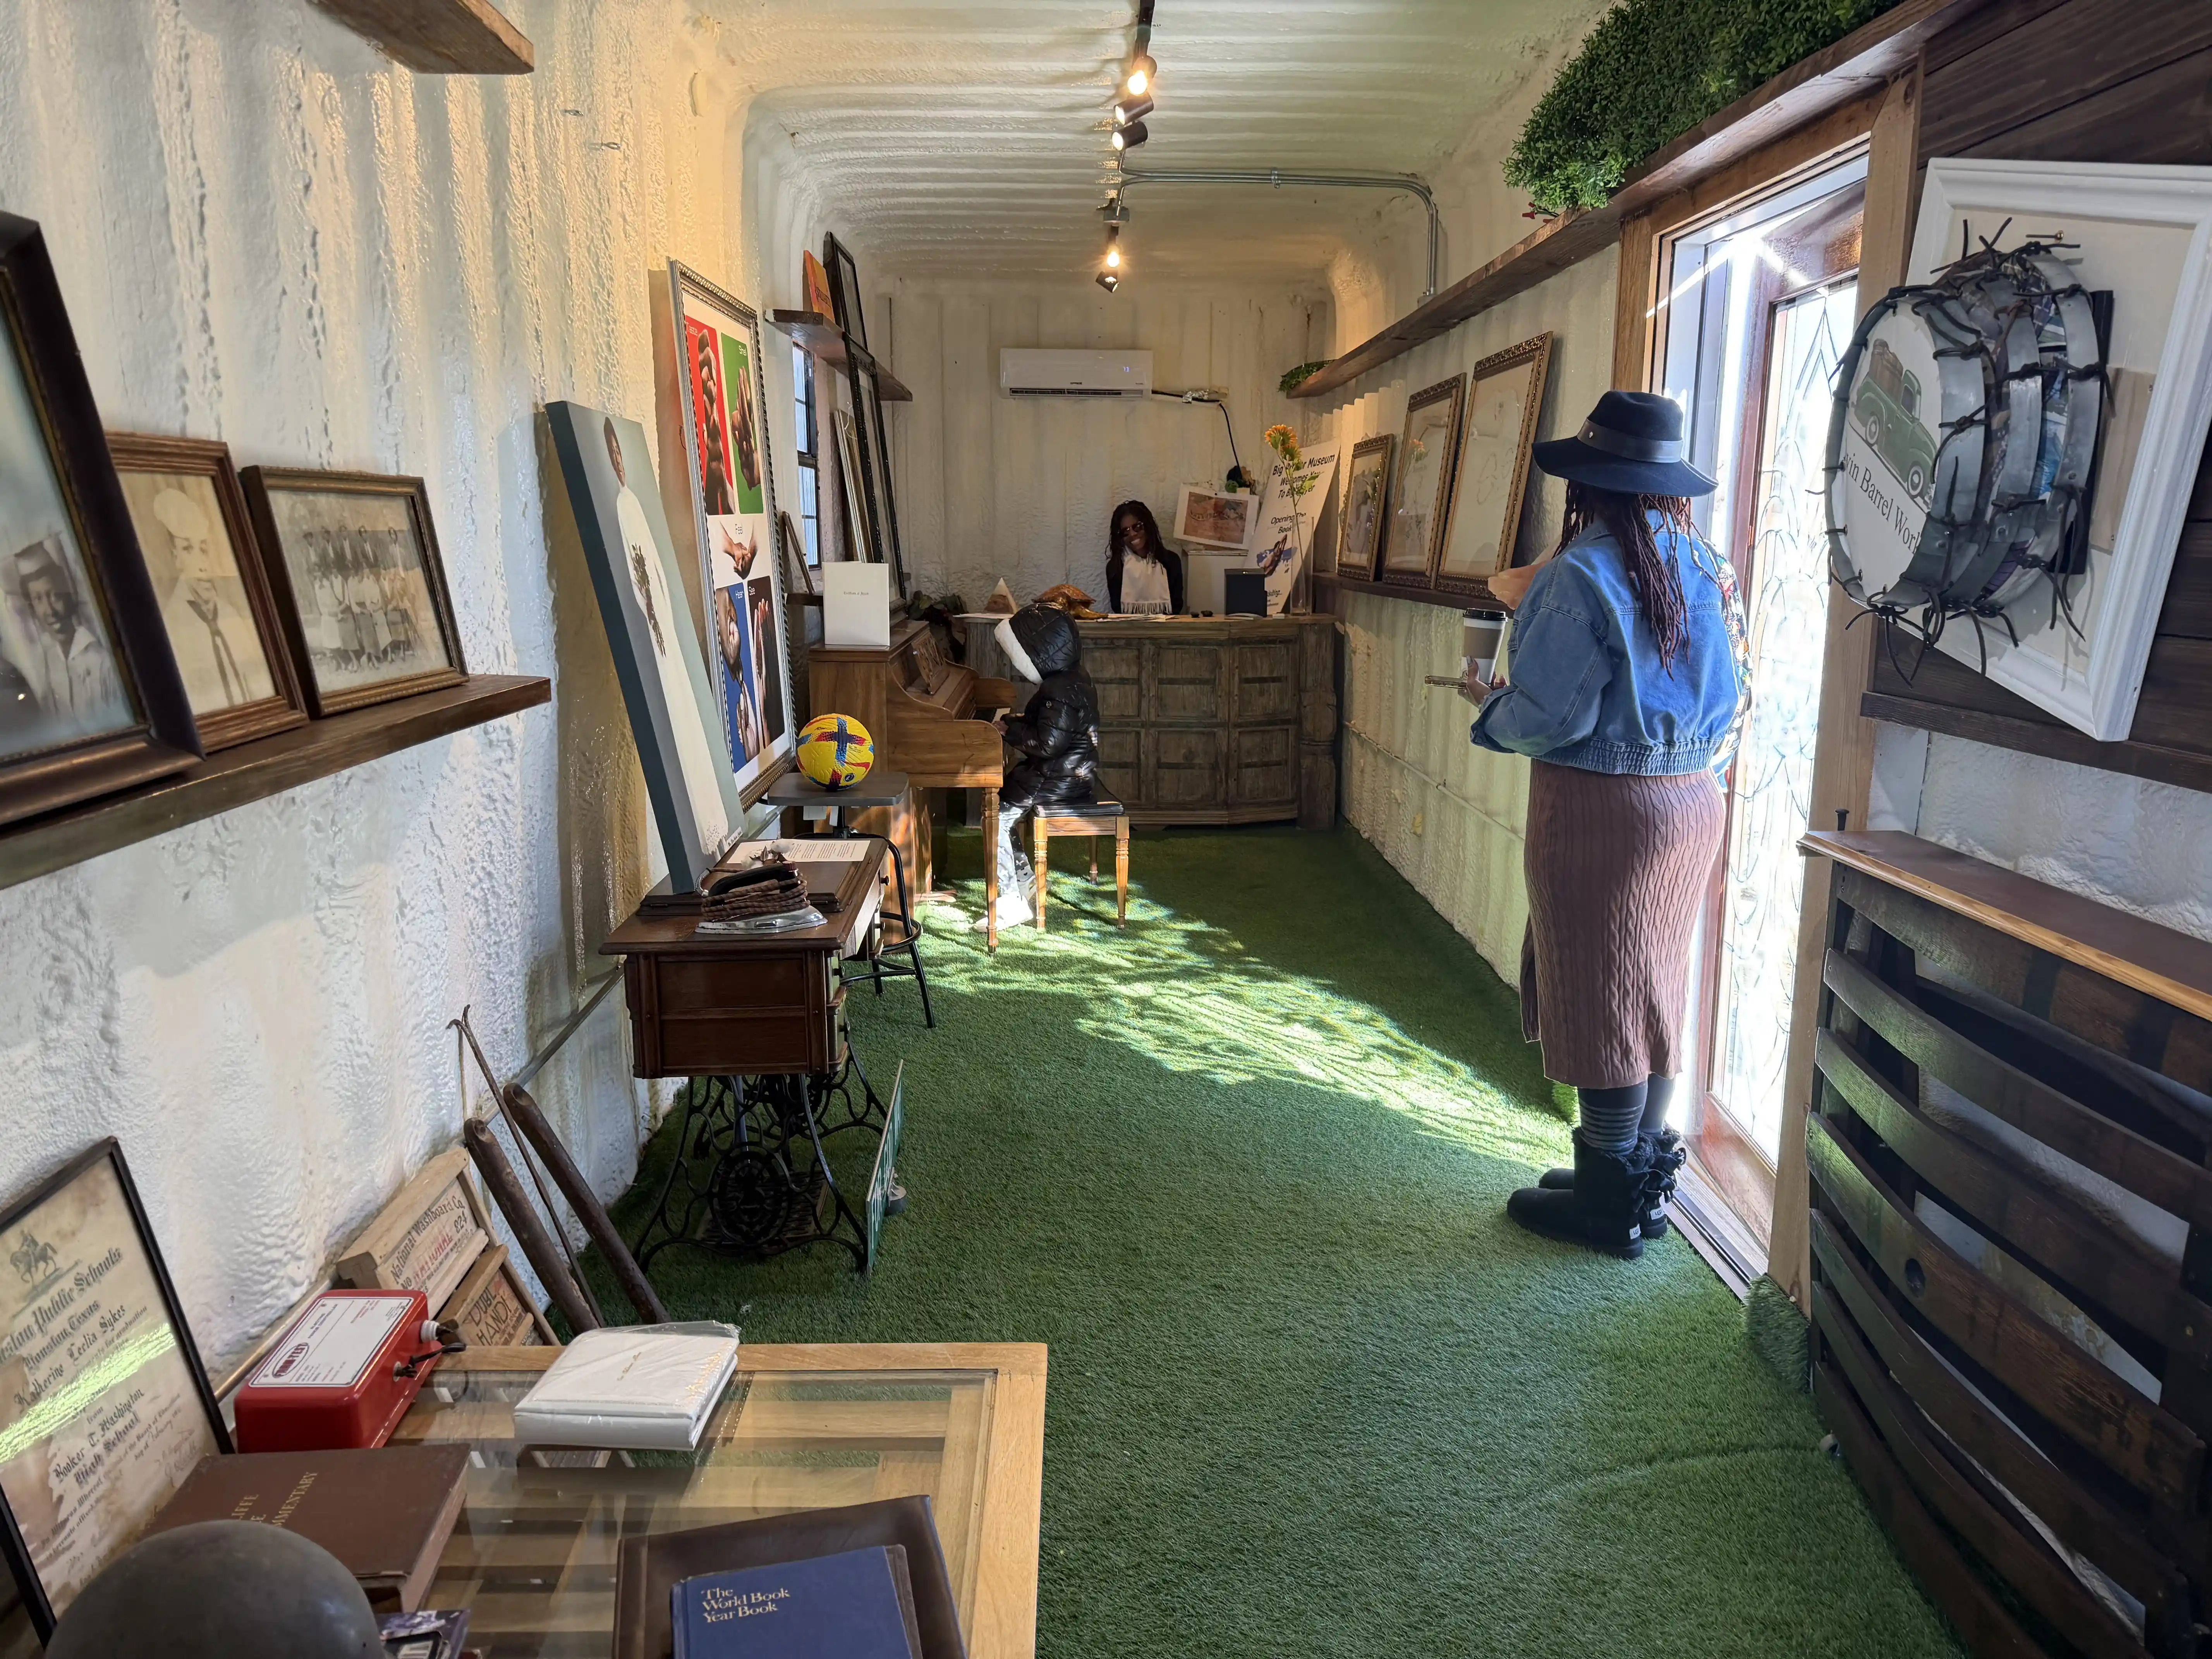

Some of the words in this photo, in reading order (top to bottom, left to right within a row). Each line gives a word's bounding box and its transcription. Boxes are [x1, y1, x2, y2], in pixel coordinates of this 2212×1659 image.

[1273, 464, 1283, 477] Big
[1307, 454, 1335, 468] Museum
[1280, 474, 1308, 486] Weomes
[1860, 466, 1893, 522] Barrel
[1271, 514, 1295, 525] Opening
[454, 1210, 467, 1234] 824
[391, 1231, 417, 1285] National
[412, 1198, 454, 1237] Washboard
[33, 1287, 76, 1338] Public
[74, 1247, 122, 1296] Schools
[68, 1300, 101, 1332] Texas
[99, 1305, 125, 1334] Sykes
[476, 1295, 512, 1346] HANDI
[53, 1448, 85, 1484] Booker
[98, 1389, 144, 1437] Washington
[232, 1494, 259, 1520] IFFE
[701, 1587, 734, 1600] The
[702, 1594, 747, 1611] World
[750, 1587, 791, 1604] Book
[703, 1610, 736, 1623] Year
[738, 1601, 778, 1617] Book
